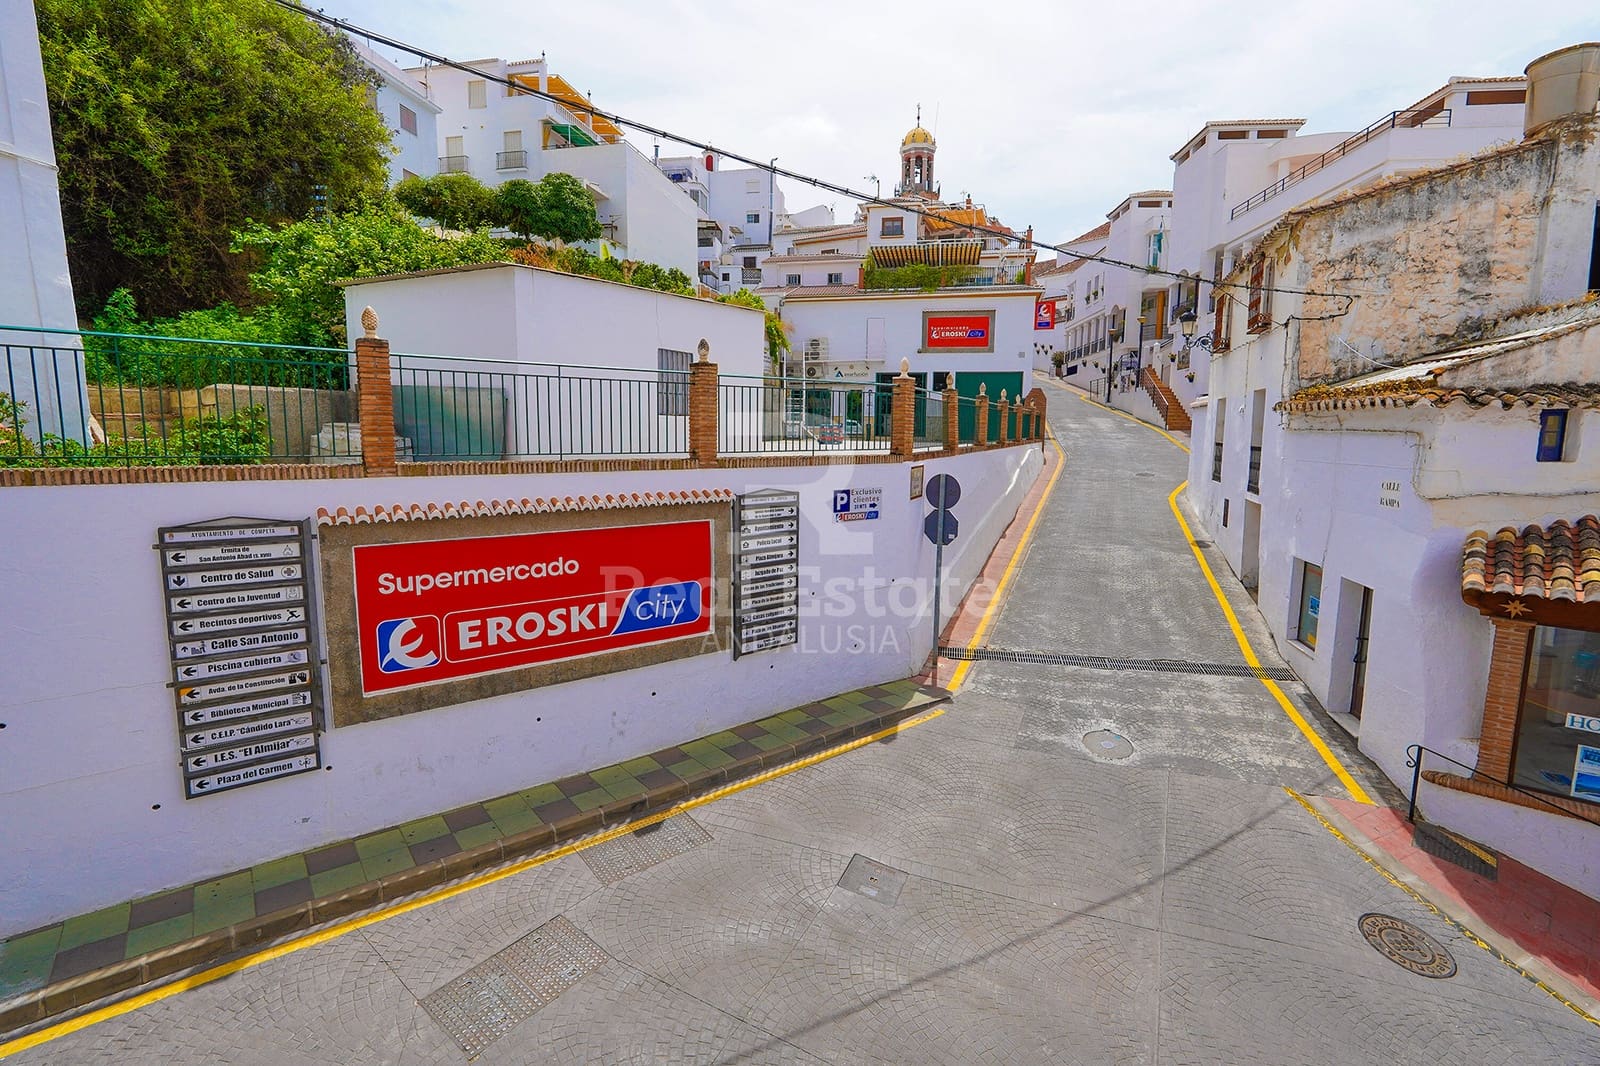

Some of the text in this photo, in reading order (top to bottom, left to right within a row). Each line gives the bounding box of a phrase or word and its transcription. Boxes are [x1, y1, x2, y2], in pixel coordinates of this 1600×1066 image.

[851, 488, 882, 496] Exclusivo
[836, 493, 848, 510] P
[191, 530, 234, 538] AYUNTAMIENTO
[212, 554, 236, 562] Antonio
[200, 569, 274, 583] Centro de Salud
[377, 557, 580, 596] Supermercado
[197, 598, 225, 607] Centro
[226, 596, 236, 604] de
[246, 592, 281, 602] Juventud
[200, 613, 282, 629] Recintos deportivos
[458, 592, 687, 651] EROSKI city
[211, 631, 299, 650] Calle San Antonio
[208, 655, 282, 673] Piscina cubierta
[208, 687, 226, 695] Avda.
[237, 682, 244, 690] la
[244, 677, 286, 689] Constitución
[210, 699, 289, 718] Biblioteca Municipal
[211, 729, 236, 740] C.E.I.P.
[214, 751, 238, 763] I.E.S.
[217, 762, 293, 785] Plaza del Carmen
